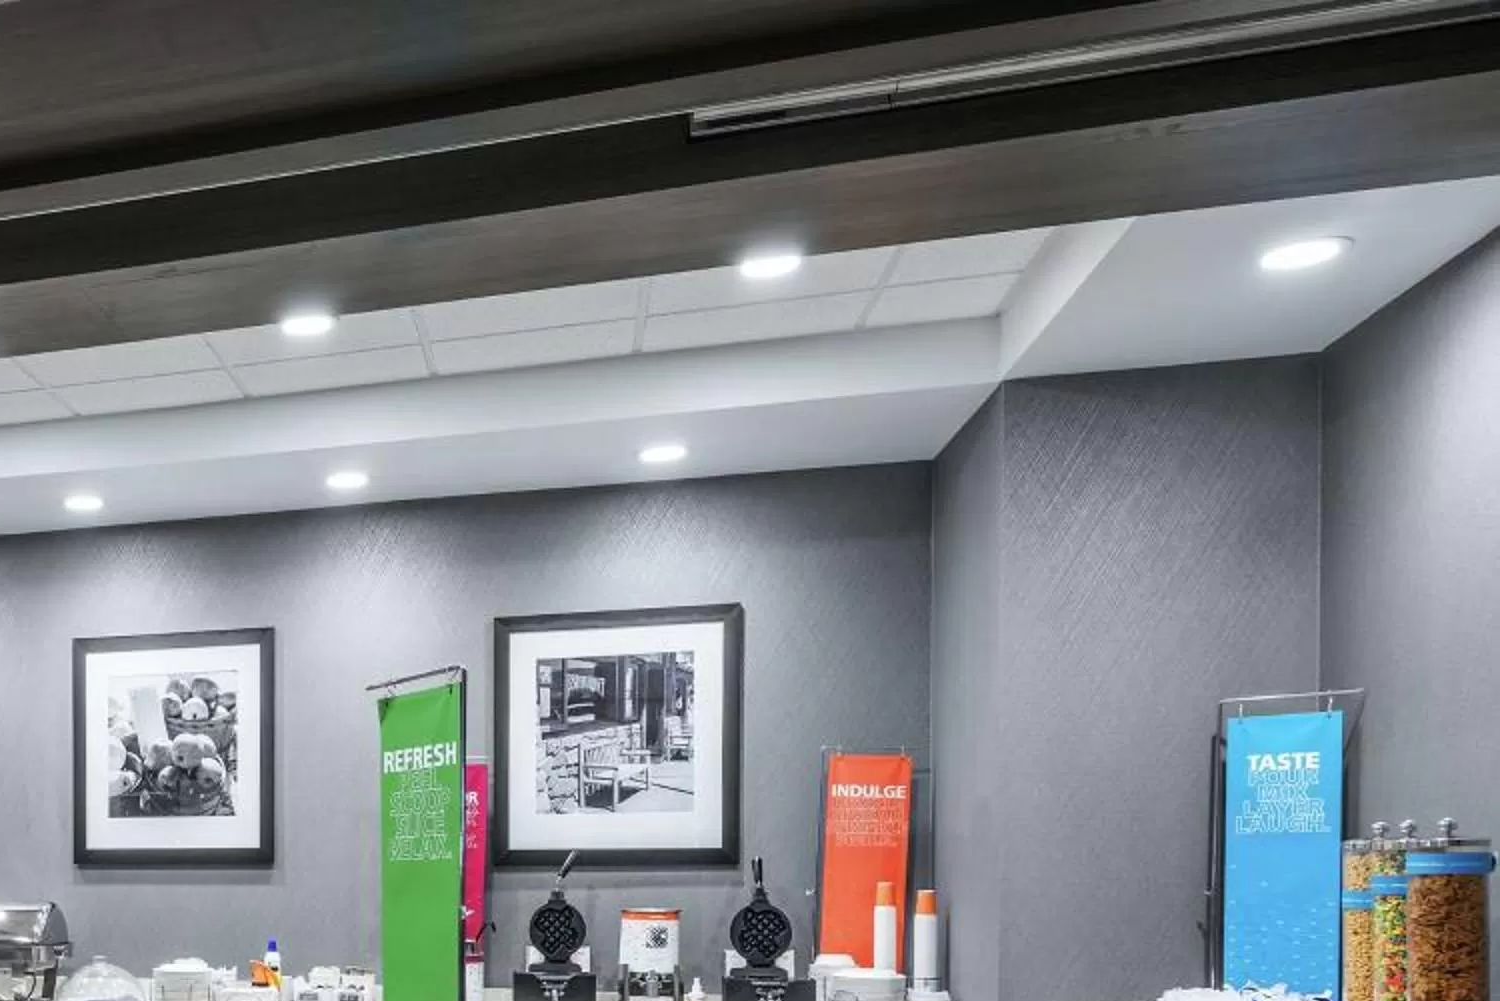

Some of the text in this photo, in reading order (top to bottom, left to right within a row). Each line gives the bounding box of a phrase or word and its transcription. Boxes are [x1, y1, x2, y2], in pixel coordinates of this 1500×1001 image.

[383, 741, 458, 774] REFRESH
[1246, 751, 1321, 772] TASTE
[1247, 768, 1320, 787] POUR
[831, 783, 908, 799] INDULGE
[1243, 797, 1325, 819] LAYER
